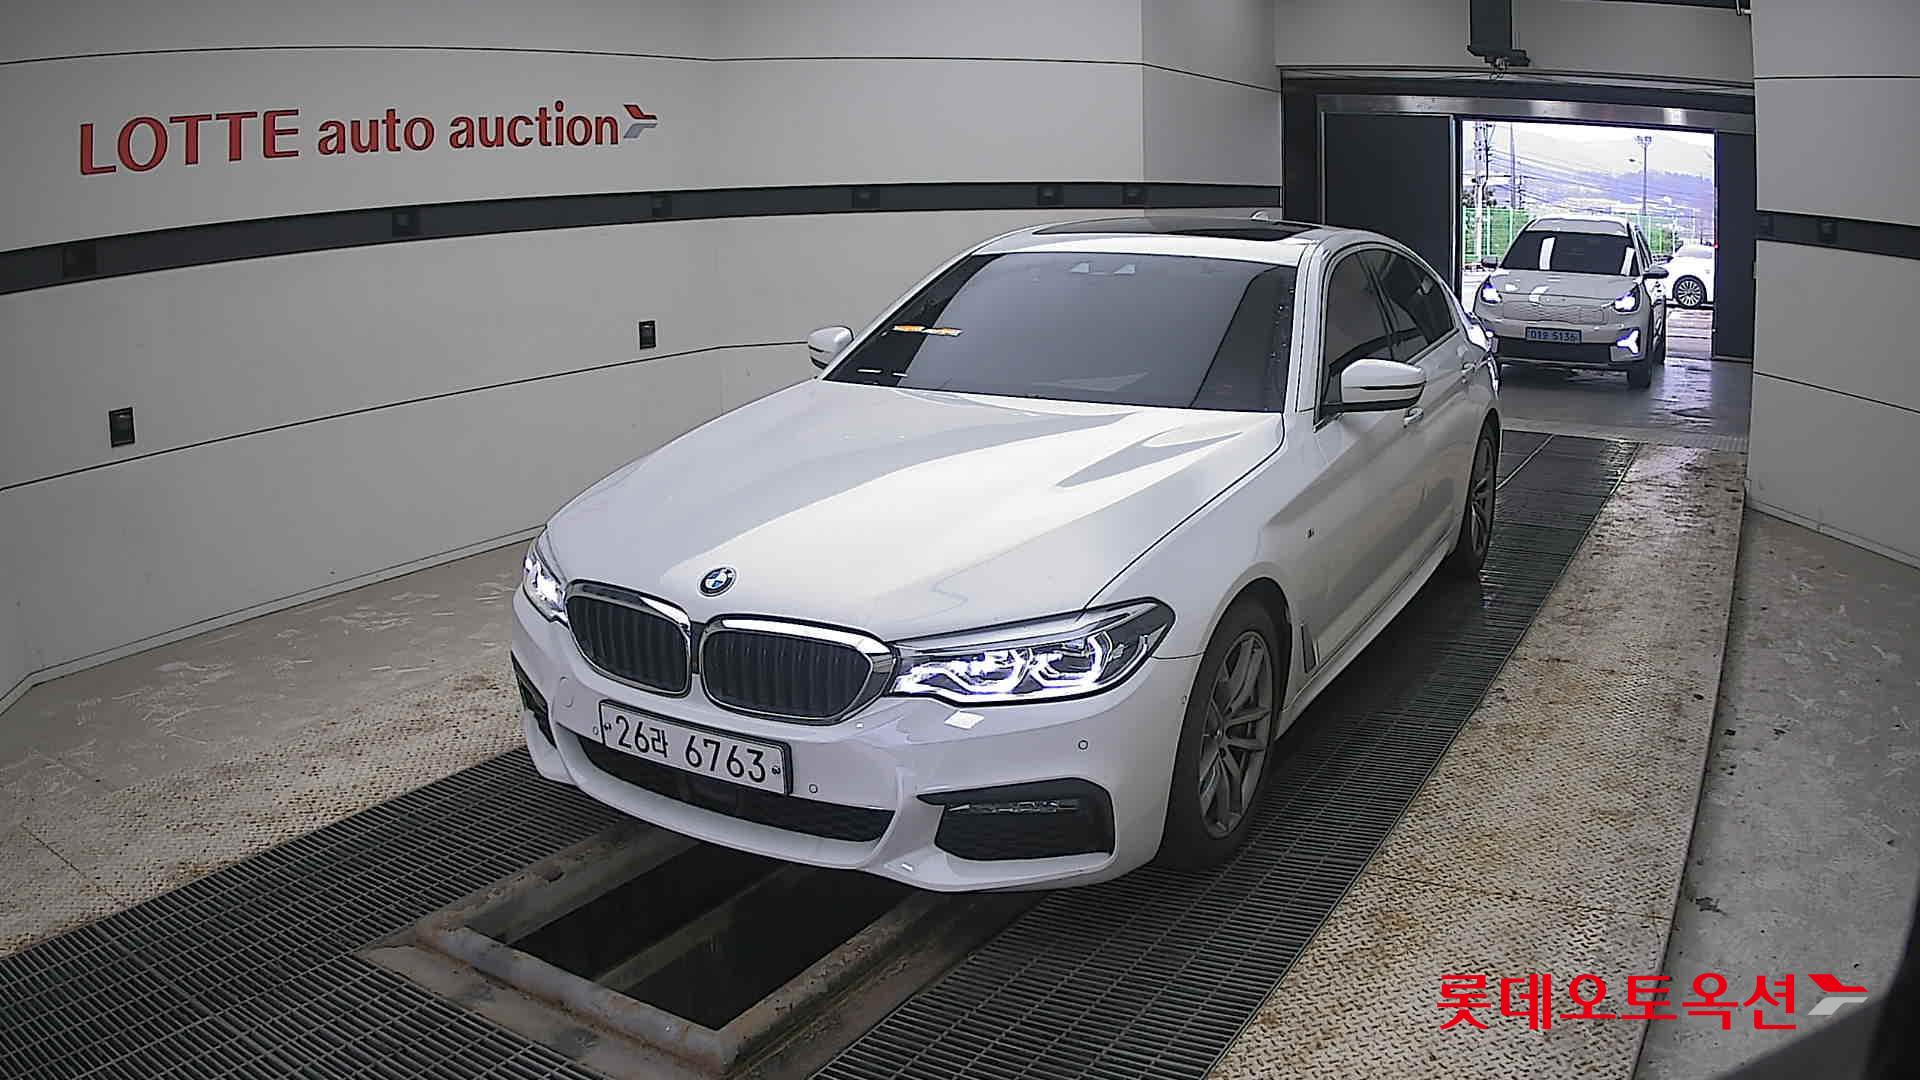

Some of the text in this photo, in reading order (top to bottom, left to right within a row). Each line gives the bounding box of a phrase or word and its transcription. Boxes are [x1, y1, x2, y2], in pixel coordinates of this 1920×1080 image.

[79, 100, 619, 175] LOTTE auto auction
[615, 715, 766, 783] 26라 6763
